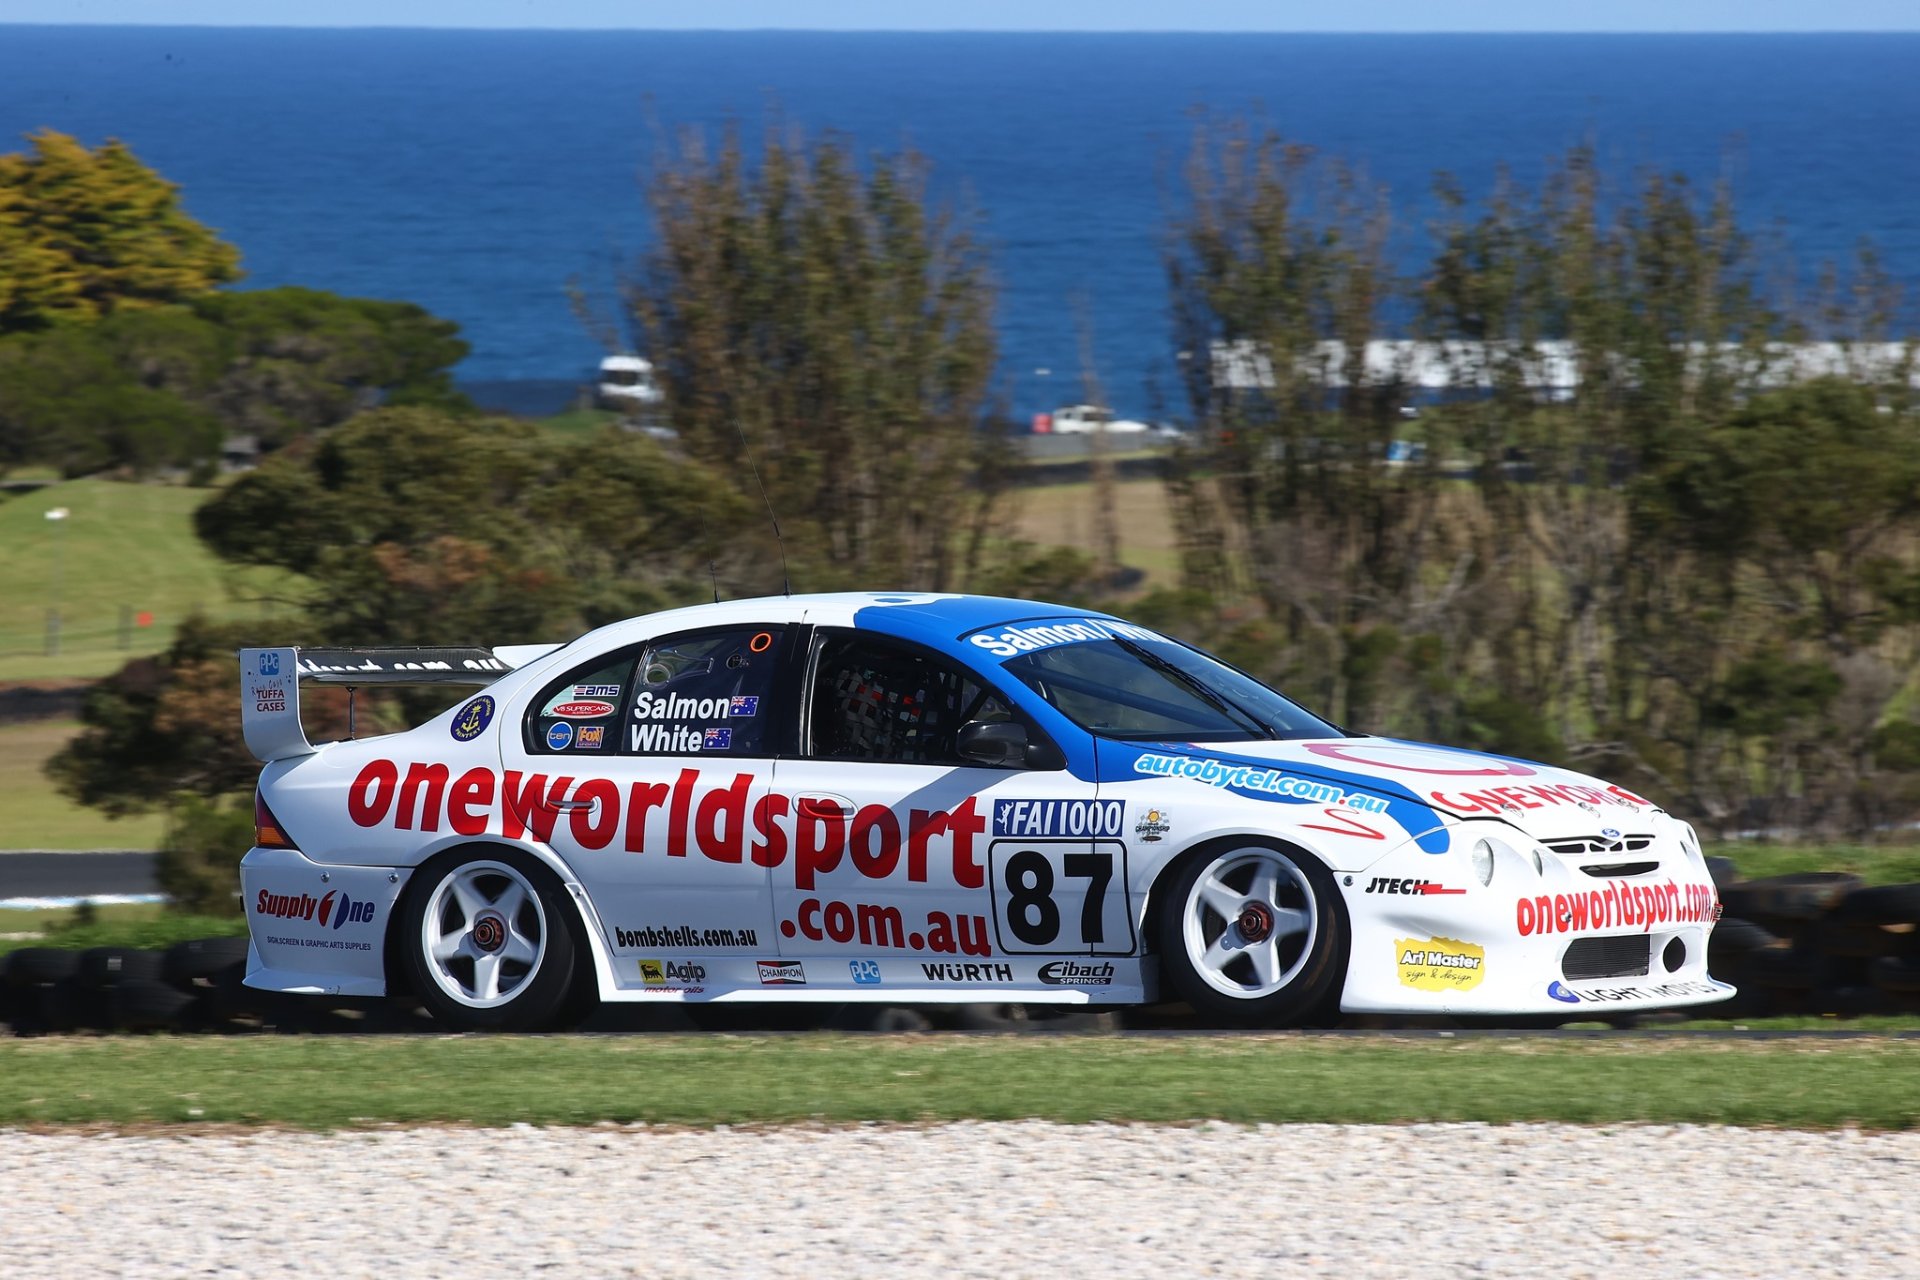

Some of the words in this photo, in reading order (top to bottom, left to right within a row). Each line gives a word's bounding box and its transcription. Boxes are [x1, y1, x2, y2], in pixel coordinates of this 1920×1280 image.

[260, 652, 279, 672] PPG
[256, 689, 284, 700] TUFFA
[256, 701, 286, 712] CASES
[633, 692, 730, 720] Salmon
[549, 732, 570, 740] ten
[579, 728, 601, 742] FOX
[631, 724, 703, 752] White
[1134, 754, 1390, 814] autobytel.com.au
[347, 758, 986, 891] oneworldsport
[1012, 801, 1057, 835] FAI
[1059, 801, 1122, 837] 1000
[1365, 877, 1430, 896] JTECH
[256, 888, 318, 921] Supply
[1004, 850, 1114, 946] 87
[614, 926, 758, 948] bombshells.com.au
[780, 898, 992, 958] .com.au
[305, 939, 329, 949] GRAPHIC
[329, 941, 344, 950] ARTS
[344, 942, 372, 951] SUPPLIES
[1400, 949, 1426, 966] Art
[1426, 951, 1481, 969] Master
[665, 961, 706, 984] Agip
[761, 967, 802, 978] CHAMPION
[850, 960, 880, 981] PPG
[1037, 961, 1115, 984] Eibach
[1059, 977, 1107, 985] SPRINGS
[1405, 970, 1426, 983] sign
[1440, 969, 1472, 985] design
